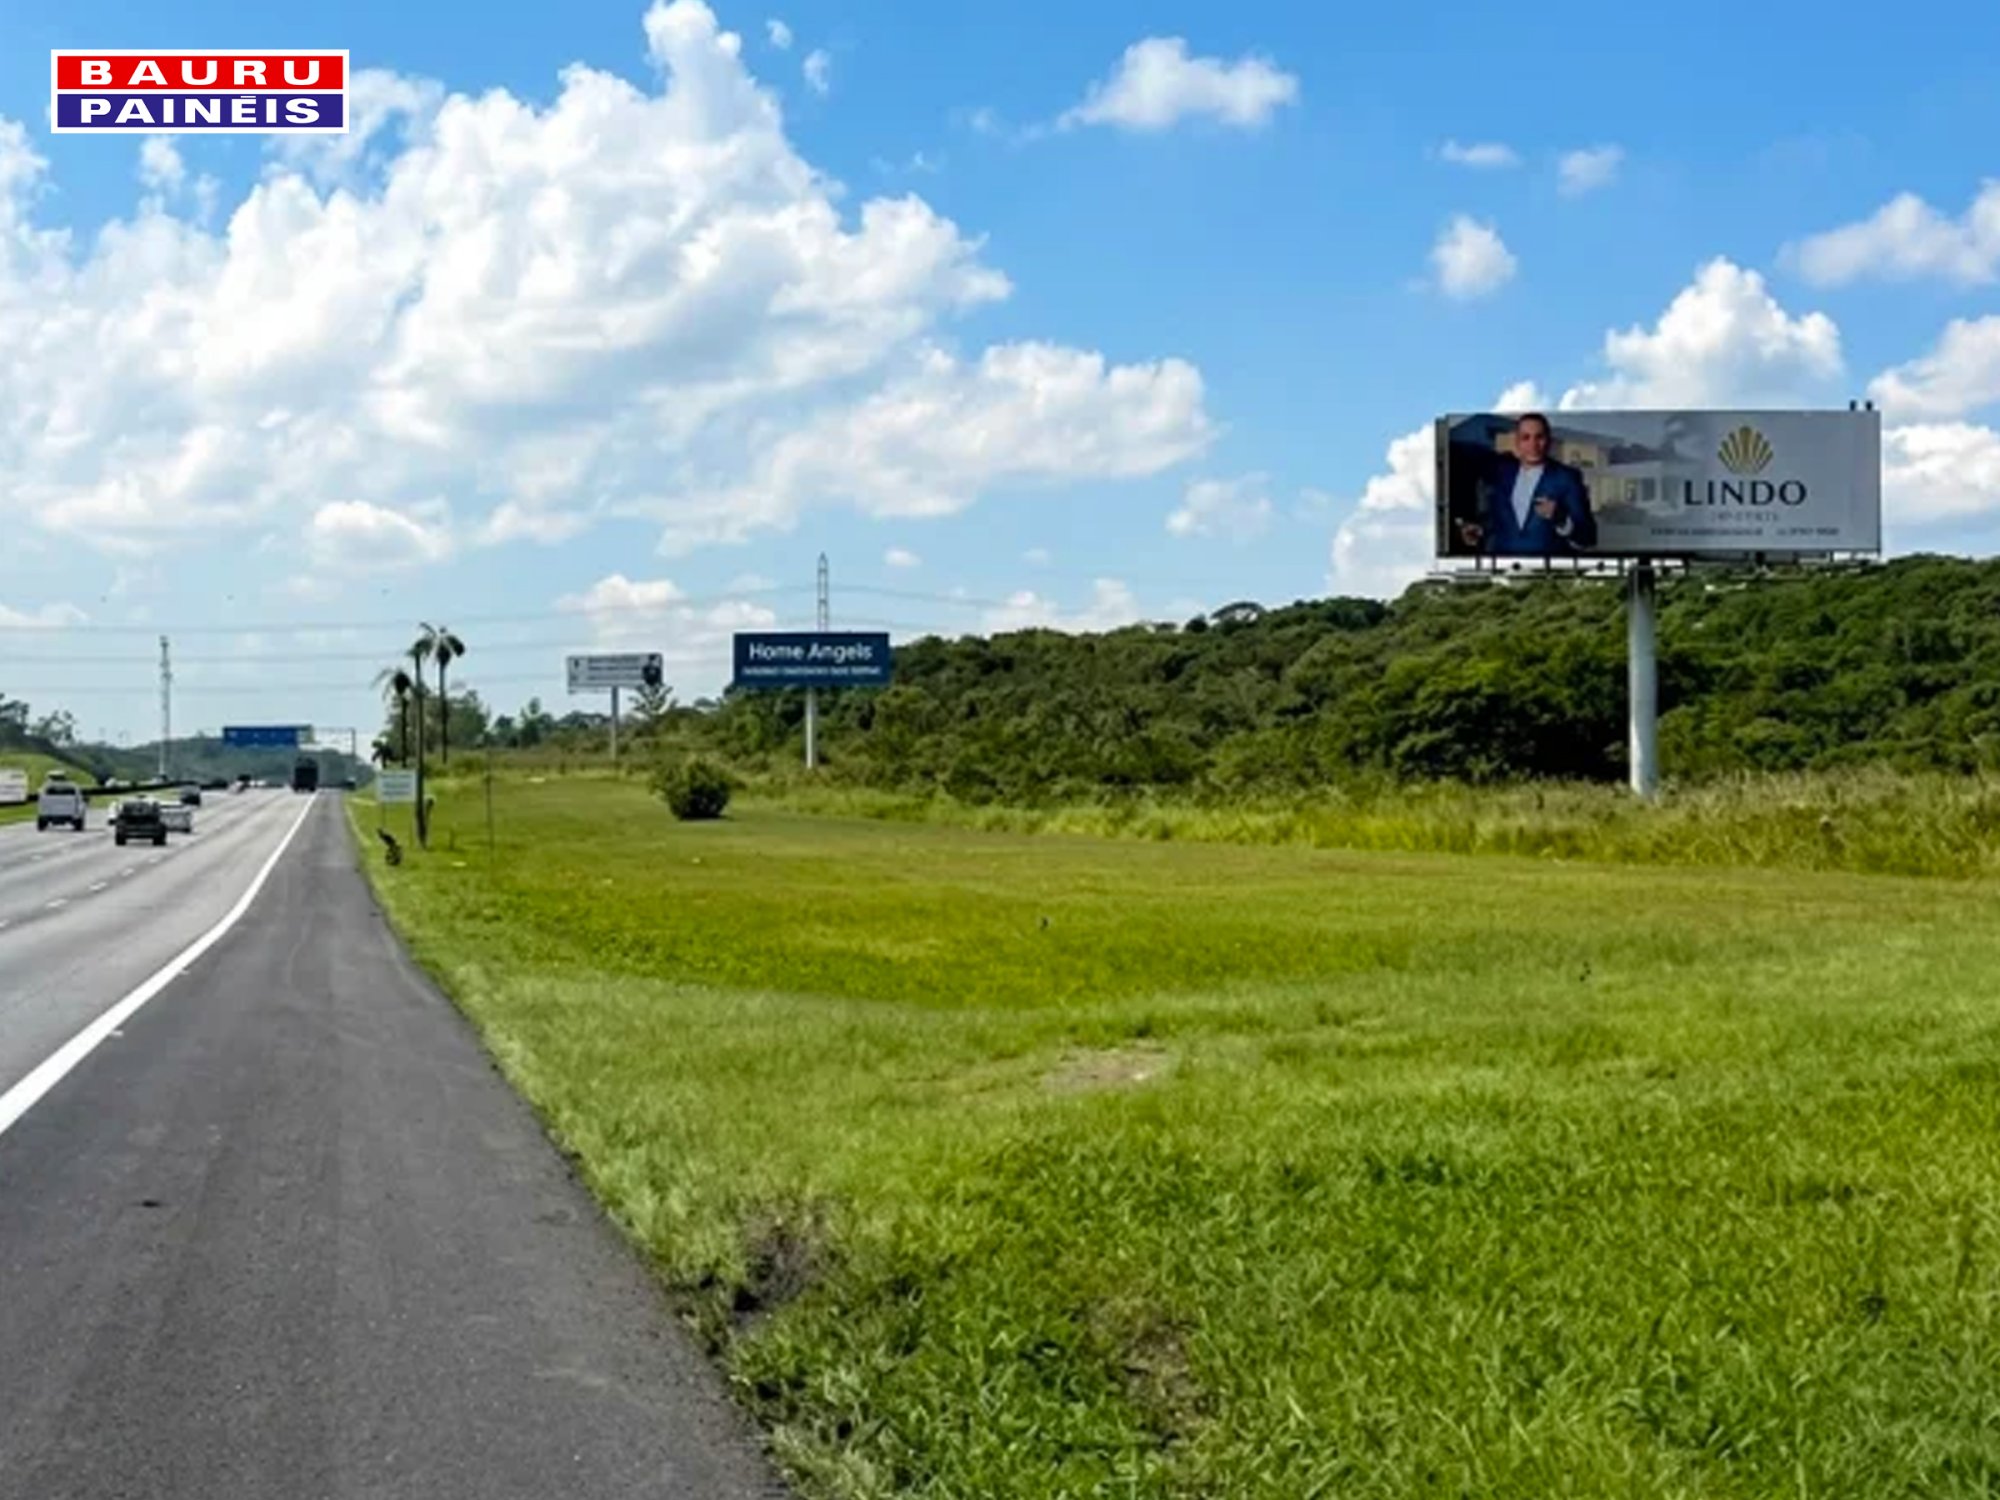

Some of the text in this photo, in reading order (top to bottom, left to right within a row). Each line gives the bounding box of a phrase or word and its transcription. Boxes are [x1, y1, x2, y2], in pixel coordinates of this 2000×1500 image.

[1684, 479, 1808, 506] LINDO
[749, 642, 873, 664] Home Angels
